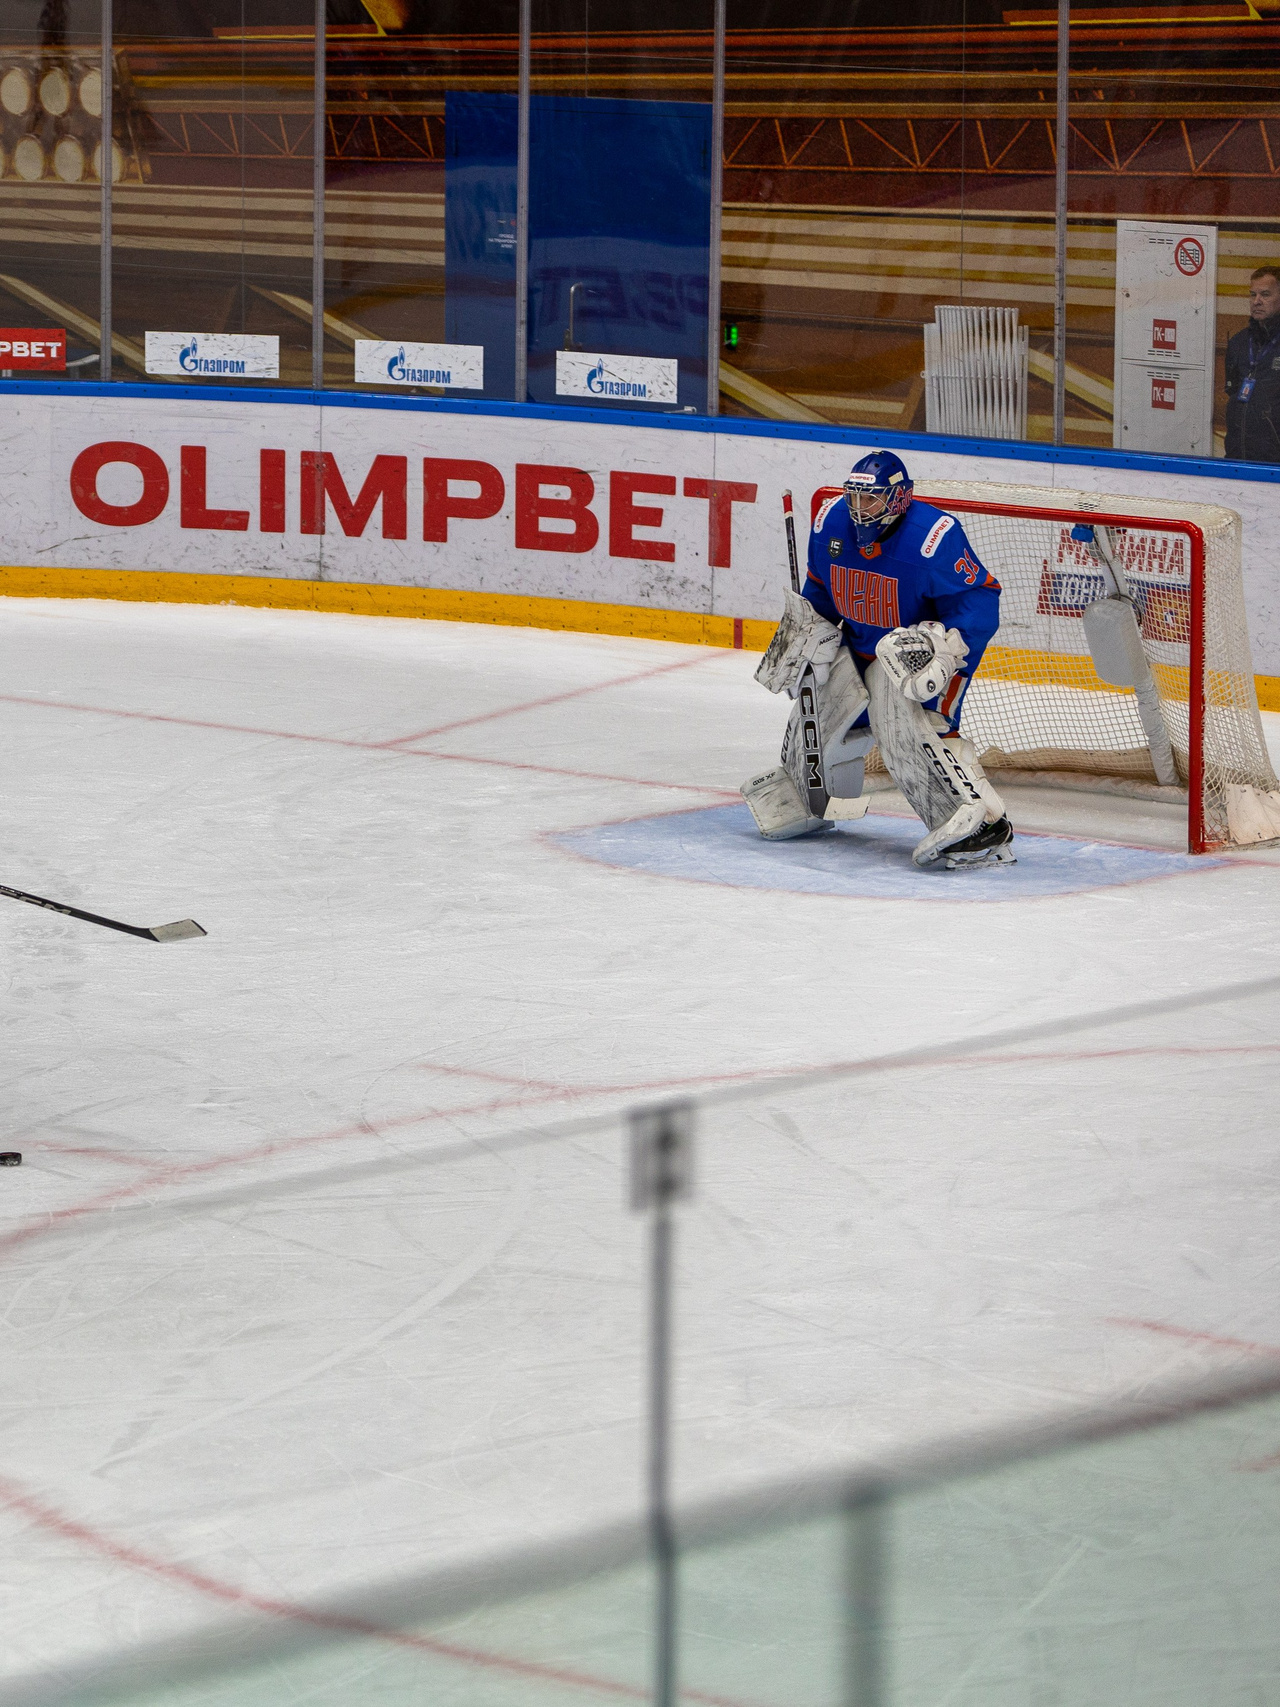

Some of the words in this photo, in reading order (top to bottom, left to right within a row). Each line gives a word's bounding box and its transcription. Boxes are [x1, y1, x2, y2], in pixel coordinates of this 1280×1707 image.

[70, 441, 758, 569] OLIMPBET
[925, 518, 950, 554] OLIMPBET
[801, 686, 823, 789] CCM
[922, 742, 960, 797] CCM
[943, 747, 983, 800] CCM
